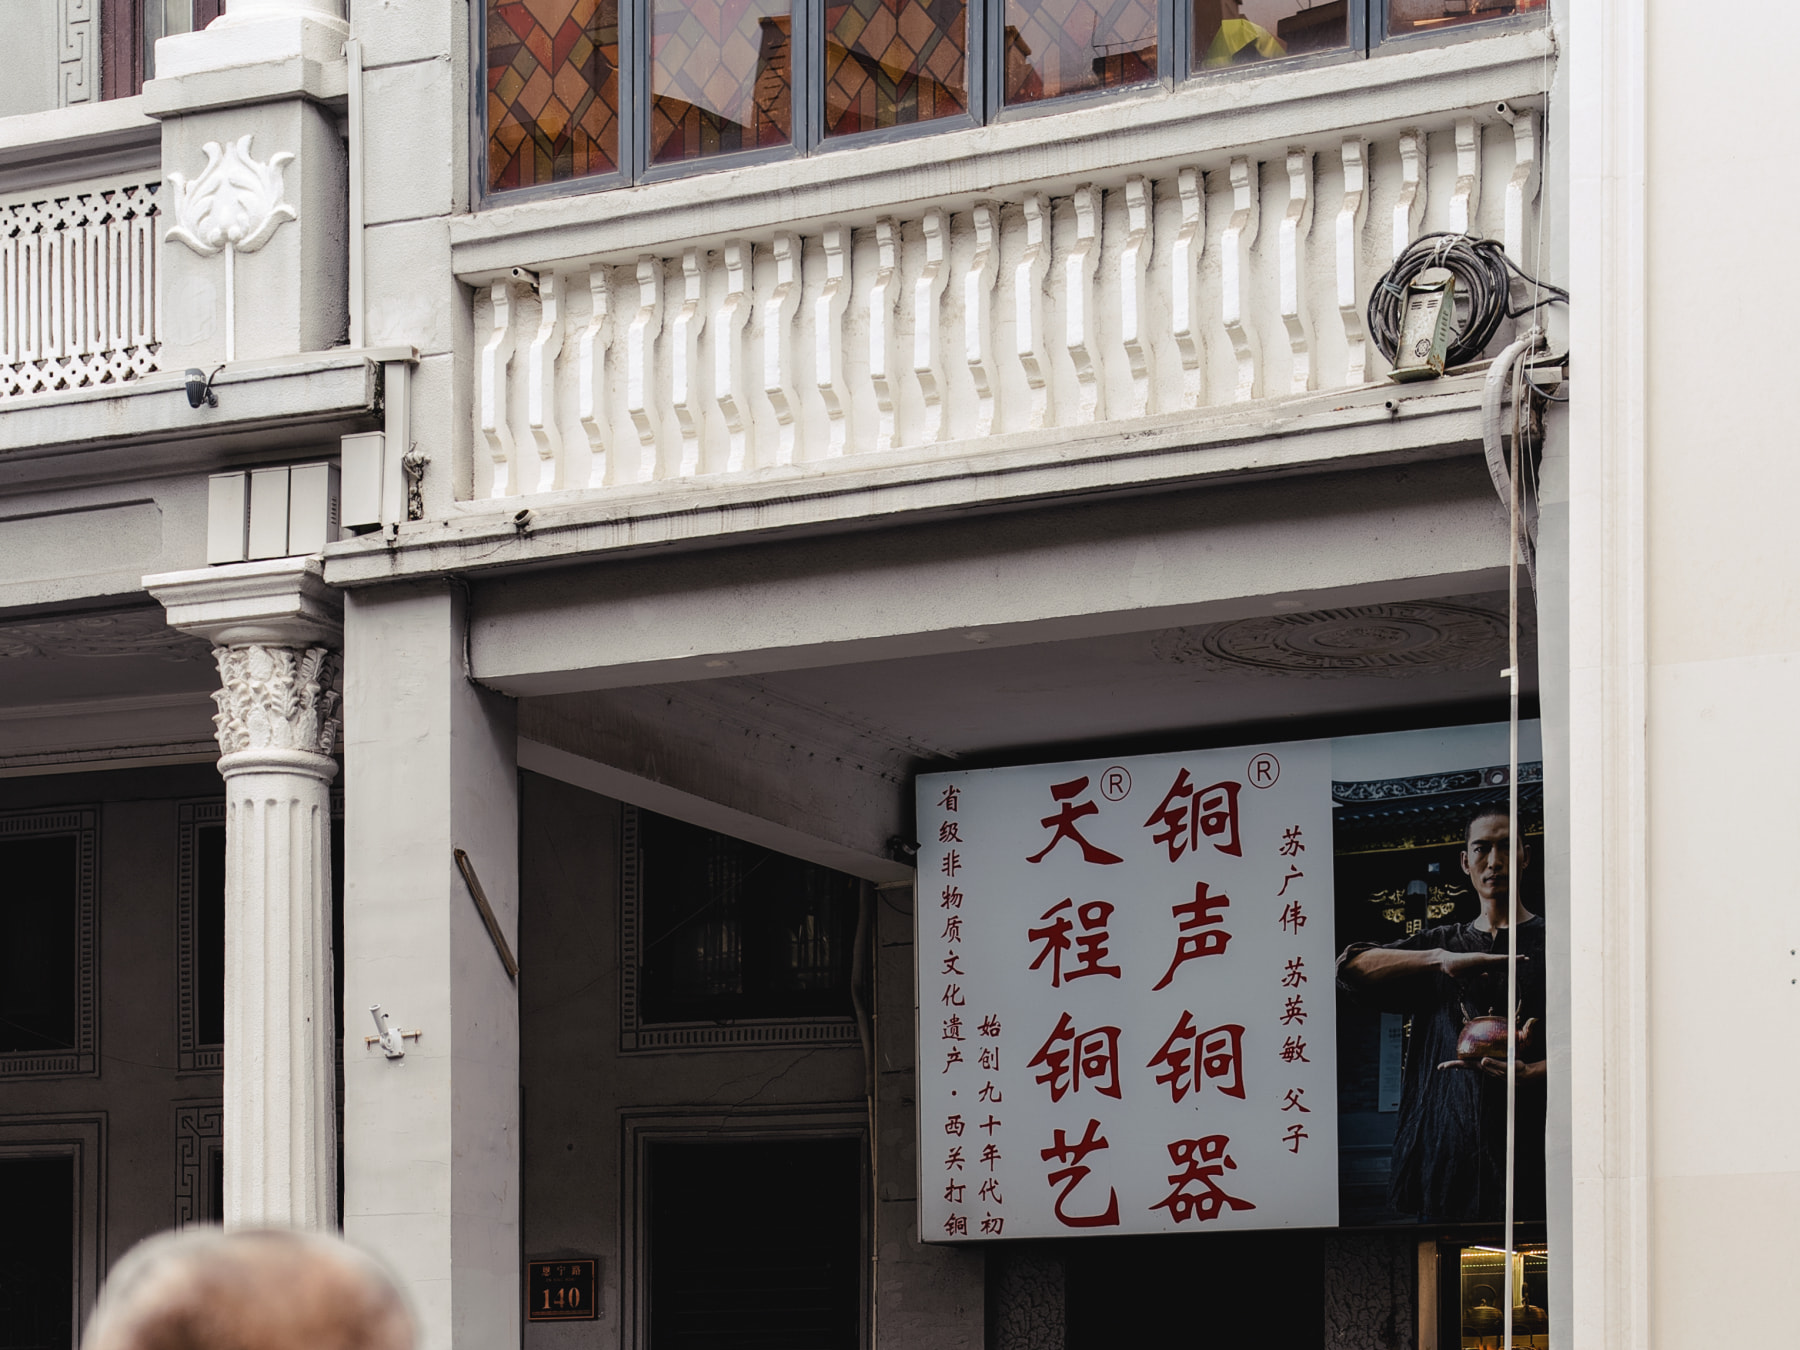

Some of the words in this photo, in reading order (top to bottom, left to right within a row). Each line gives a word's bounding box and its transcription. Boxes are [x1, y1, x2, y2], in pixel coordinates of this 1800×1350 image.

[1277, 825, 1307, 935] 苏广伟
[1025, 775, 1124, 1228] 天程铜艺
[1144, 767, 1256, 1224] 铜声铜器
[1279, 956, 1311, 1064] 苏英敏
[978, 1014, 1004, 1235] 始创九十年代初
[1280, 1086, 1311, 1155] 父子
[542, 1287, 580, 1309] 140
